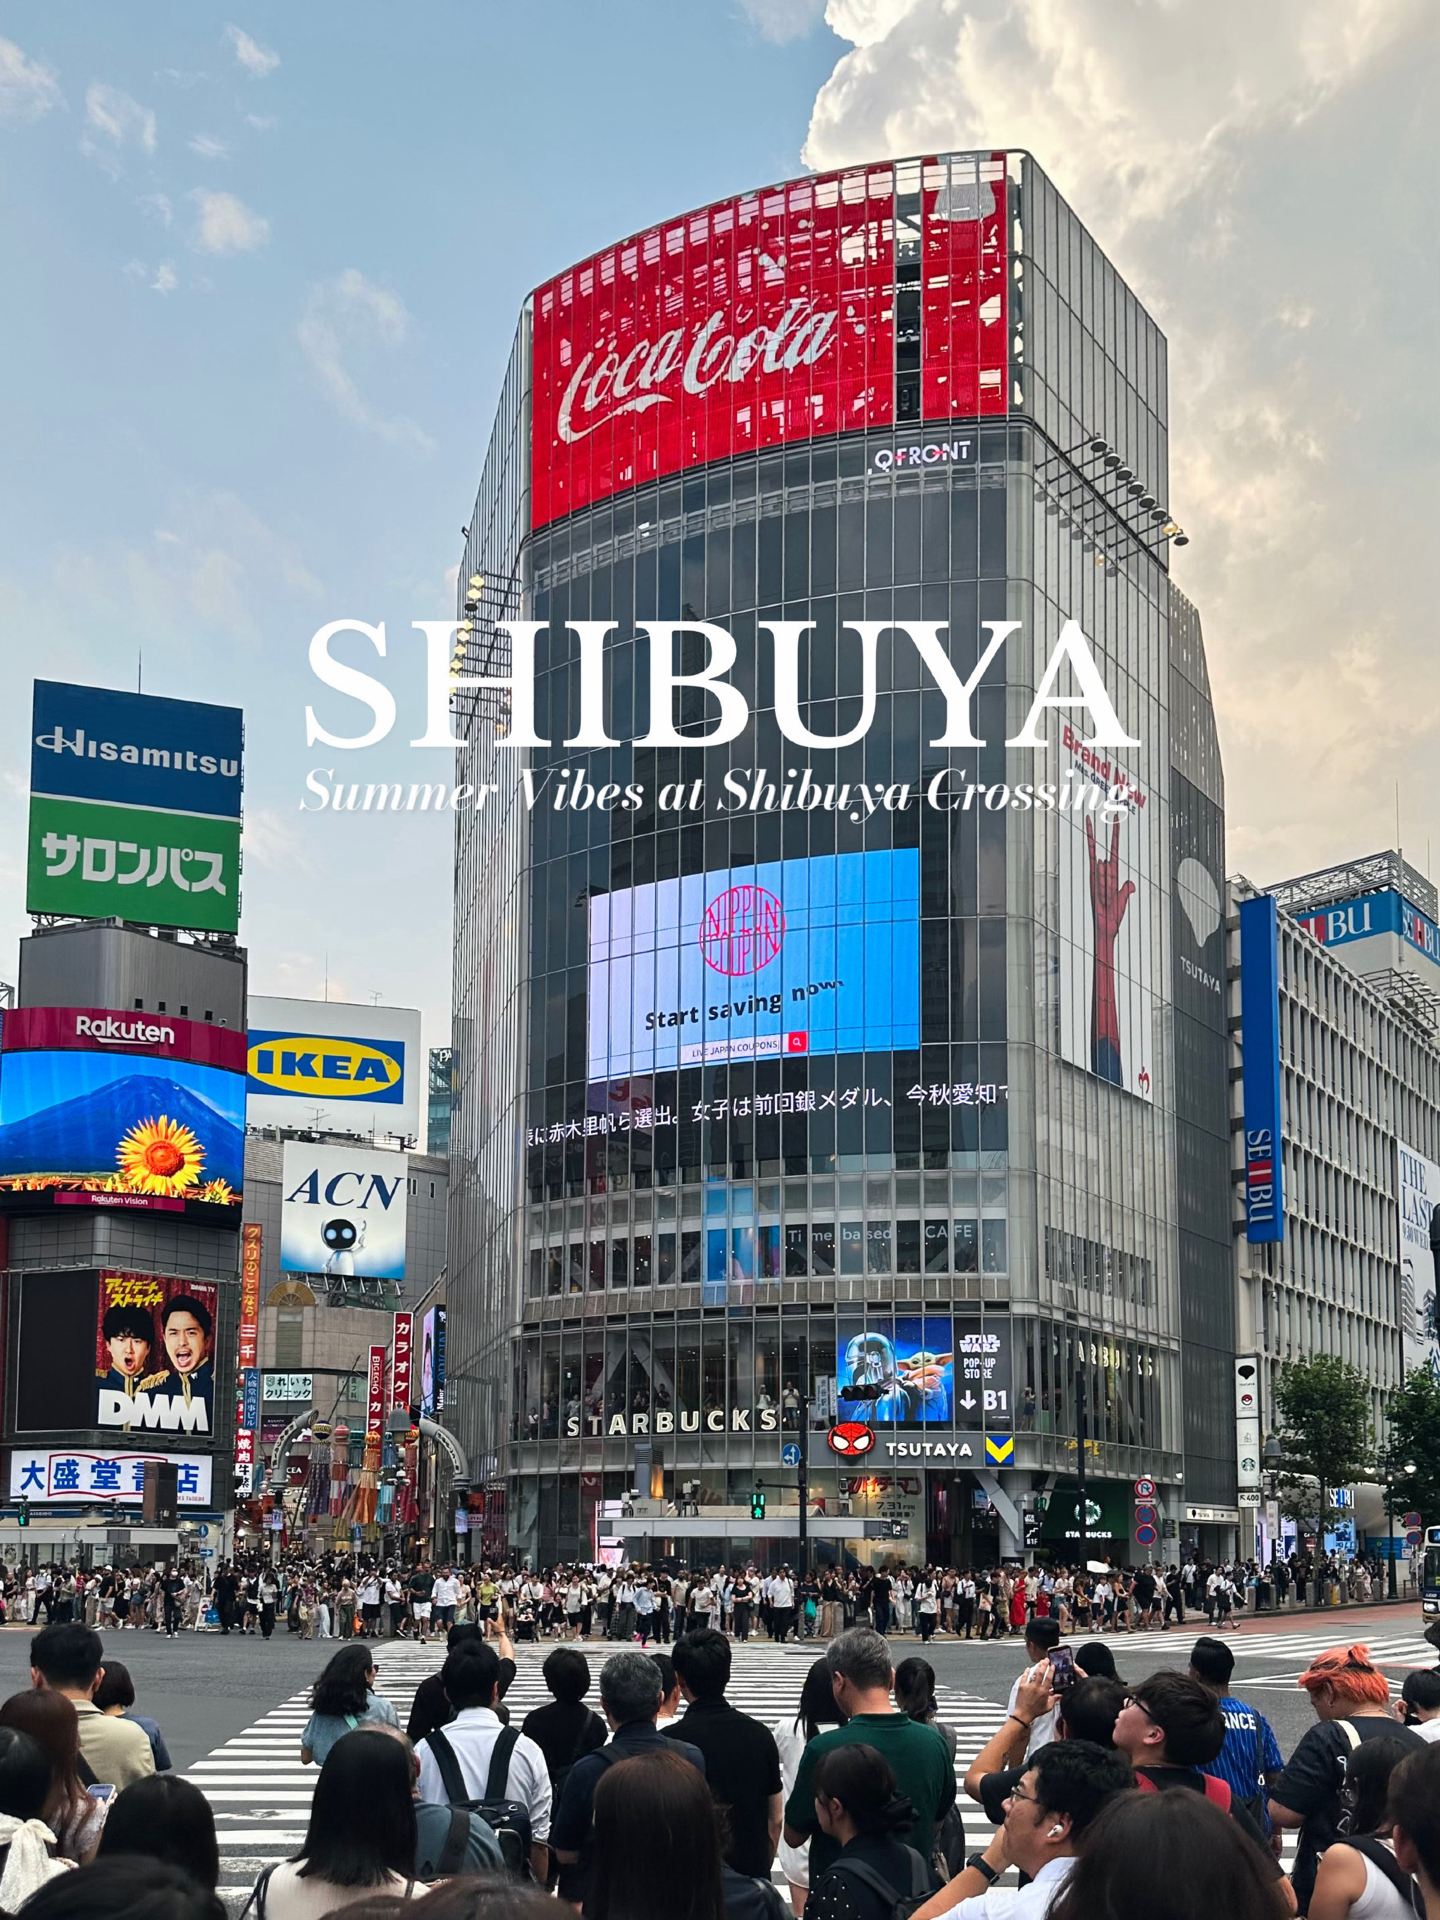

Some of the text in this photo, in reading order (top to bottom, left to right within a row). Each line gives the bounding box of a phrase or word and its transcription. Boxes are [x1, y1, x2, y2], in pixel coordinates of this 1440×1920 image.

[874, 440, 971, 472] QFRONT
[36, 725, 239, 778] Hisamitsu
[1063, 725, 1111, 781] Brand
[42, 832, 227, 897] サロンパス
[1180, 955, 1222, 995] TSUTAYA
[644, 1006, 699, 1031] Start
[708, 993, 783, 1022] saving
[76, 1015, 175, 1045] Rakuten
[691, 1040, 778, 1058] LIVE JAPAN COUPONS
[257, 1049, 391, 1084] IKEA
[1246, 1128, 1274, 1225] SEIBU
[1400, 1150, 1427, 1195] THE
[91, 1194, 148, 1206] Rakuten Vision
[285, 1168, 405, 1210] ACN
[925, 1224, 972, 1239] CAFE
[244, 1227, 259, 1317] クスリのことなら
[959, 1334, 1000, 1345] STAR
[963, 1357, 996, 1369] POP-UP
[1053, 1336, 1153, 1377] STARBUKS
[277, 1376, 312, 1387] れいわ
[964, 1368, 993, 1379] STORE
[265, 1388, 311, 1399] クリニック
[983, 1389, 1007, 1411] B1
[98, 1389, 209, 1432] DMM
[567, 1409, 777, 1437] STARBUCKS
[886, 1442, 972, 1457] TSUTAYA
[1065, 1530, 1113, 1539] STABUCKS
[1223, 1711, 1256, 1730] ANCE
